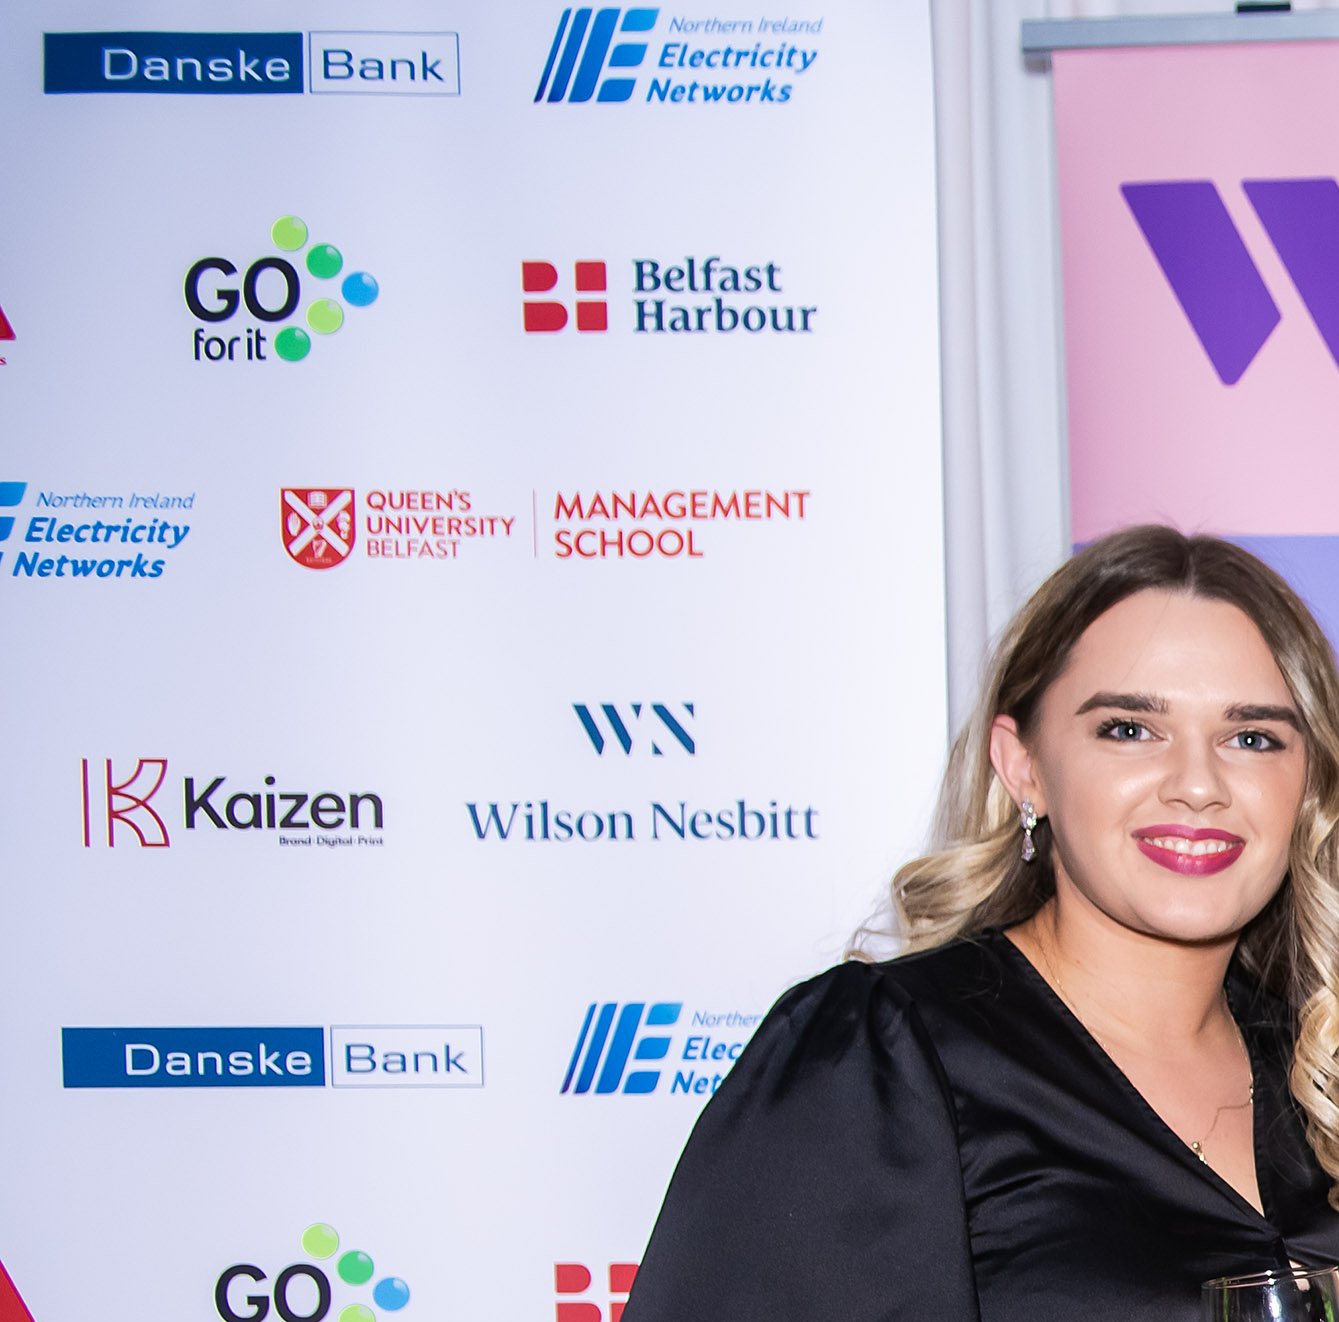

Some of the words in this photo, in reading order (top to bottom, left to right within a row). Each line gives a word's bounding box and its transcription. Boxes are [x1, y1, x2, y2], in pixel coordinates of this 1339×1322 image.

[669, 16, 752, 34] Northern
[758, 16, 823, 34] Ireland
[104, 48, 290, 81] Danske
[323, 49, 443, 81] Bank
[658, 43, 817, 73] Electricity
[646, 78, 792, 103] Networks
[635, 258, 781, 292] Belfast
[185, 257, 300, 323] GO
[635, 298, 816, 332] Harbour
[194, 328, 240, 361] for
[246, 328, 266, 360] it
[36, 492, 123, 508] Northern
[129, 493, 195, 509] Ireland
[366, 490, 471, 512] QUEEN'S
[555, 492, 809, 520] MANAGEMENT
[25, 517, 190, 549] Electricity
[367, 516, 514, 536] UNIVERSITY
[367, 539, 459, 558] BELFAST
[555, 529, 703, 558] SCHOOL
[13, 552, 165, 578] Networks
[185, 776, 383, 829] Kaizen
[467, 801, 634, 840] Wilson
[652, 800, 816, 840] Nesbitt
[691, 1010, 764, 1028] Norther
[126, 1043, 312, 1075] Danske
[346, 1044, 467, 1073] Bank
[681, 1036, 742, 1061] Elec
[670, 1069, 721, 1095] Net
